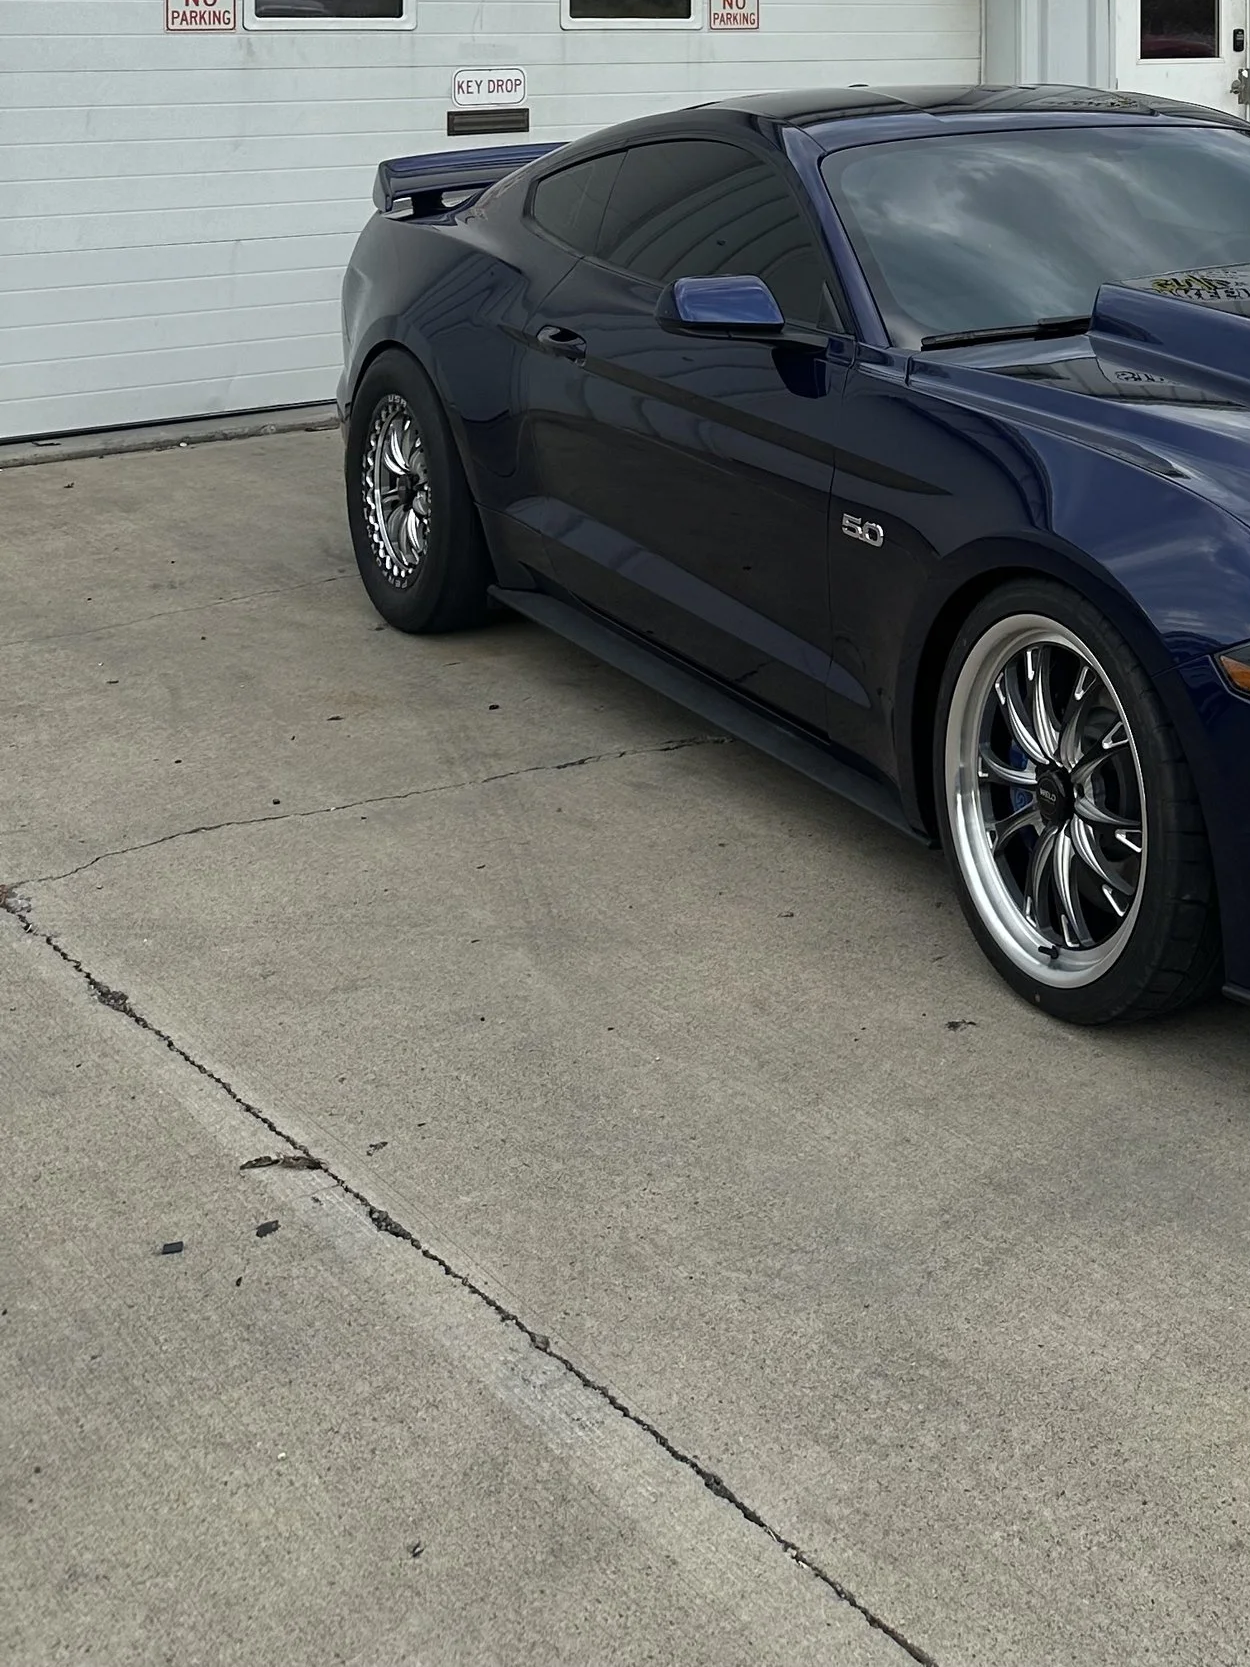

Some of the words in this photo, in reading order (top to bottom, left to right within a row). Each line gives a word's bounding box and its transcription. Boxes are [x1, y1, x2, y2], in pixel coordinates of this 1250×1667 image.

[171, 10, 231, 26] PARKING
[713, 12, 756, 26] PARKING
[457, 80, 483, 95] KEY
[488, 79, 523, 93] DROP
[388, 394, 407, 409] USA
